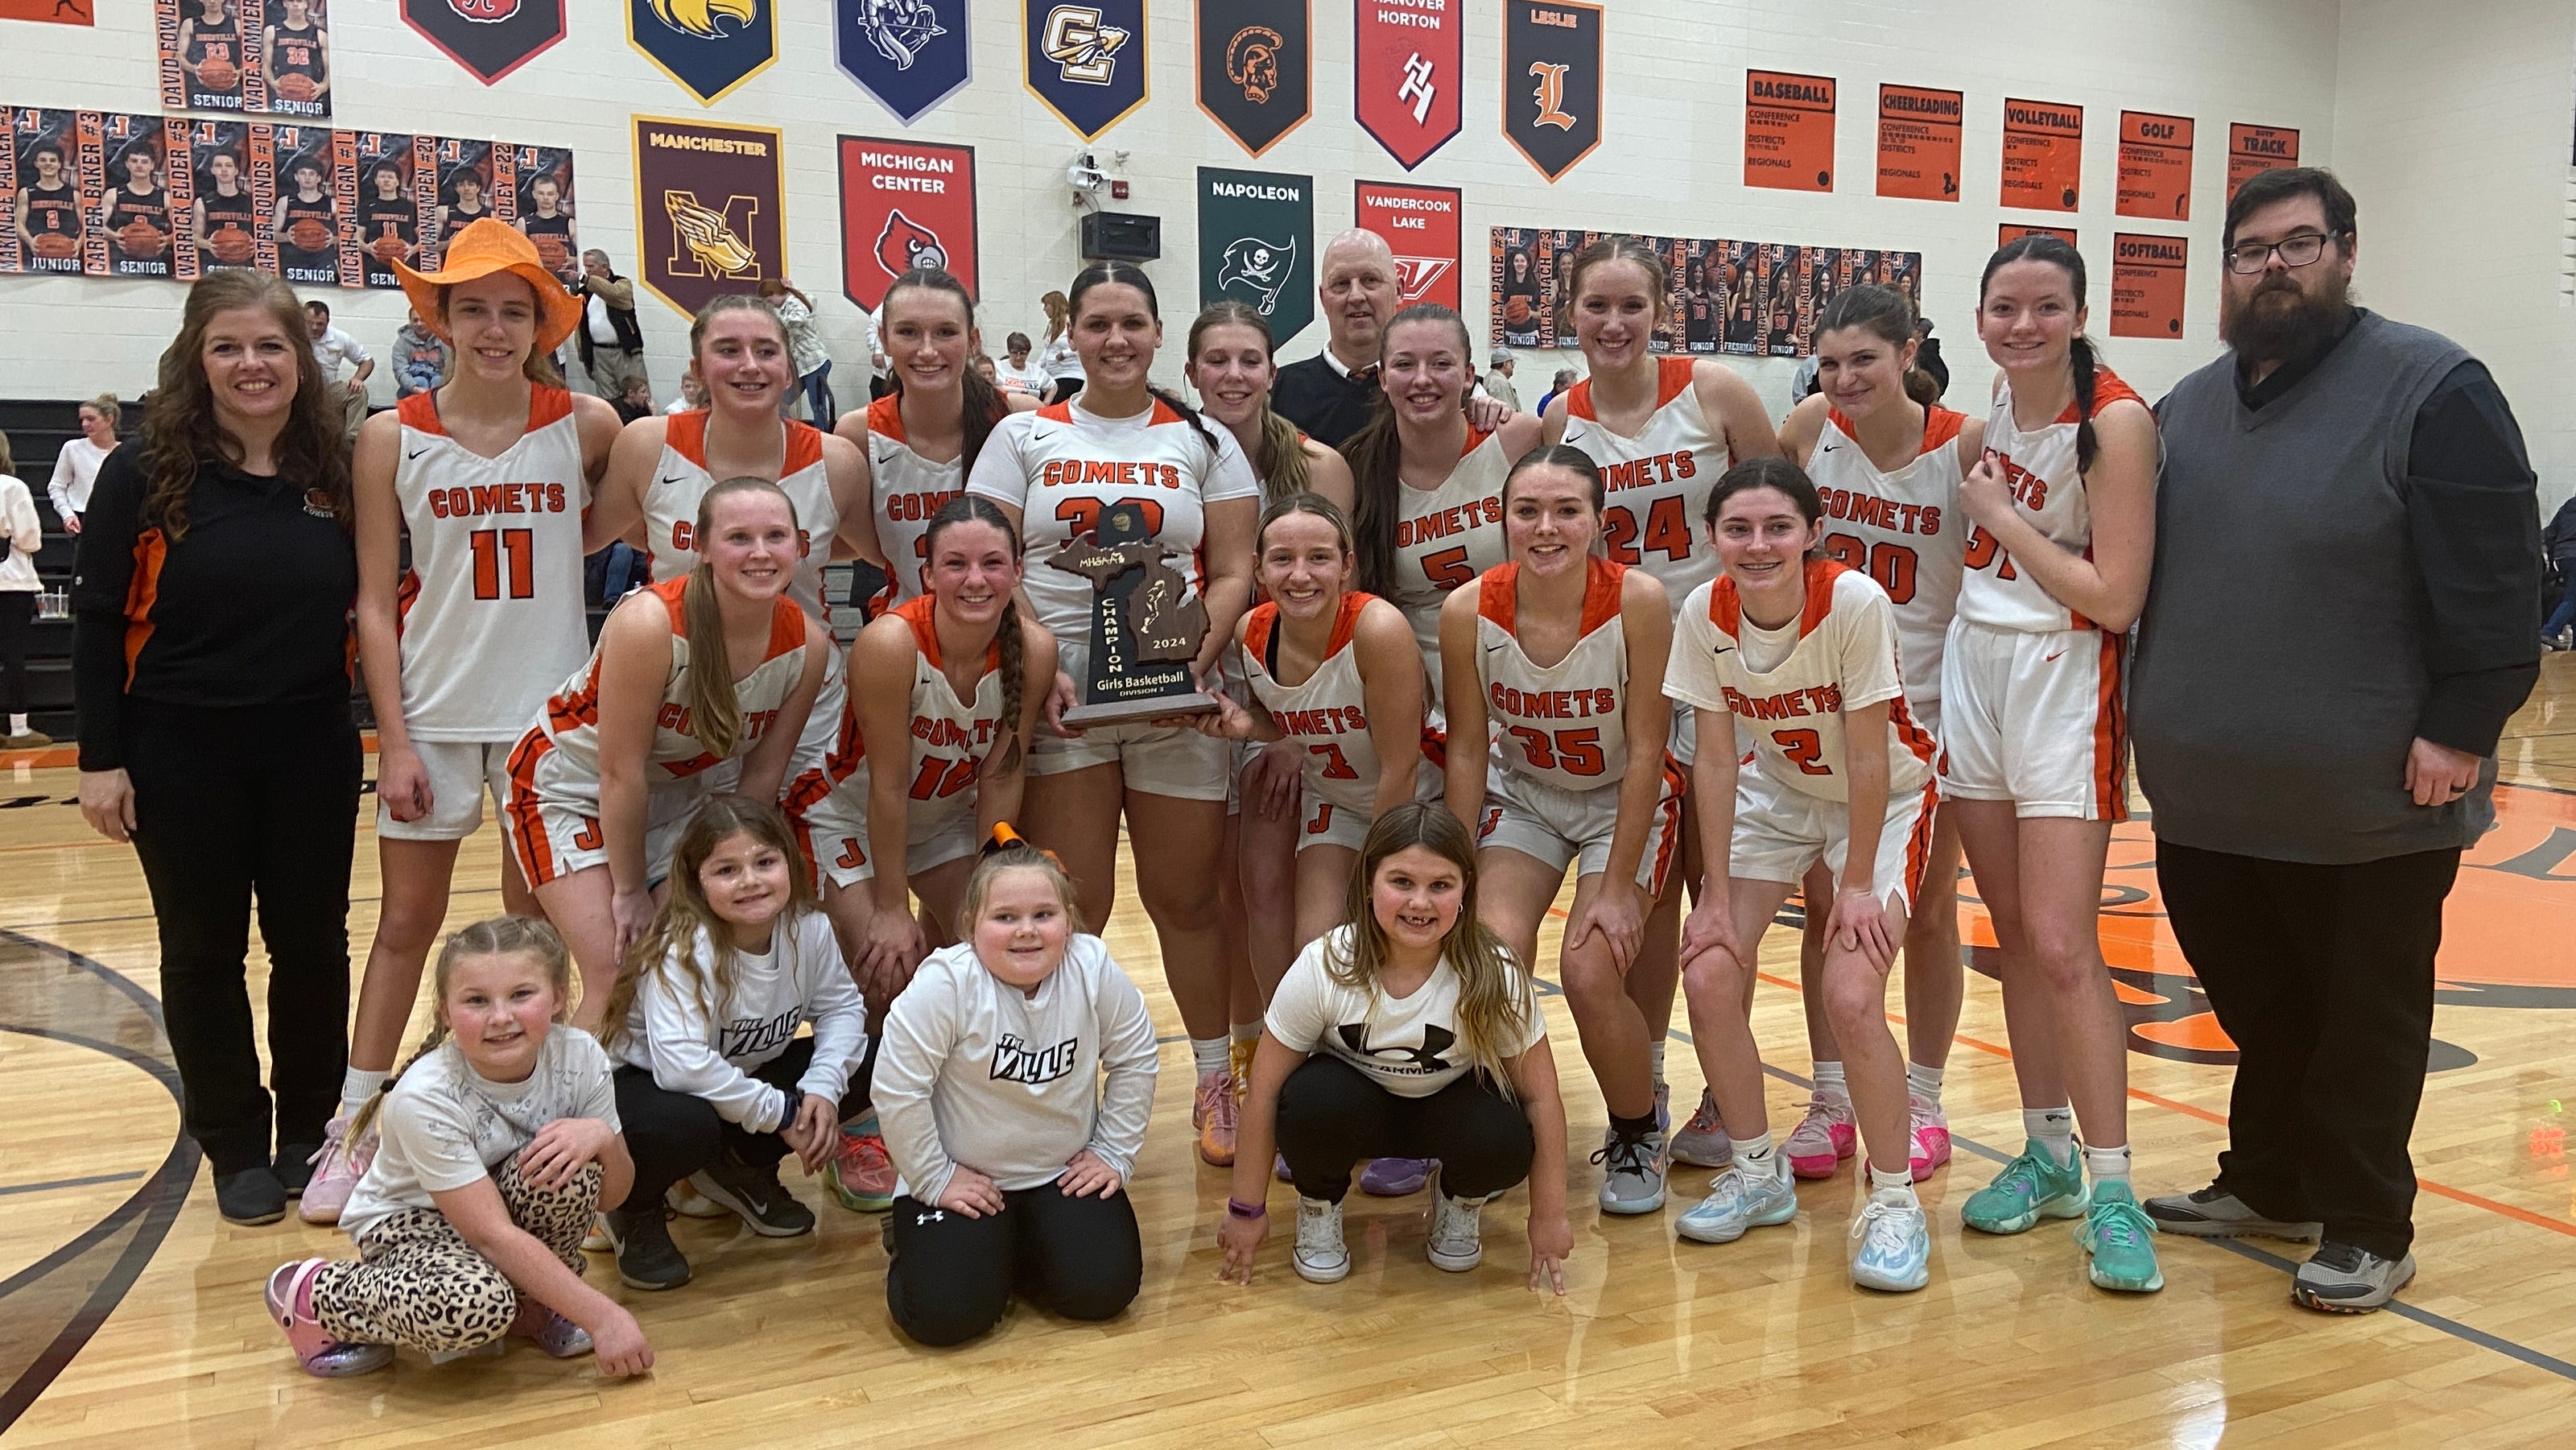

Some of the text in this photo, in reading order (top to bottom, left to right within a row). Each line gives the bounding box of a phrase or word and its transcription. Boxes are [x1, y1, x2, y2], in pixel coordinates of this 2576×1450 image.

[1373, 0, 1445, 11] OVER
[1377, 10, 1440, 30] HORTON
[1530, 9, 1578, 29] LESLIE
[162, 58, 183, 107] DAVID
[245, 68, 264, 110] WADE
[1753, 81, 1830, 104] BASEBALL
[194, 93, 243, 109] SENIOR
[275, 98, 324, 115] SENIOR
[1529, 61, 1578, 132] L
[1883, 93, 1959, 117] CHEERLEADING
[1748, 109, 1801, 122] CONFERENCE
[2007, 108, 2079, 130] VOLLEYBALL
[1748, 134, 1785, 146] DISTRICTS
[1880, 122, 1930, 134] CONFERENCE
[2140, 122, 2175, 139] GOLF
[649, 132, 767, 157] MANCHESTER
[1880, 143, 1916, 155] DISTRICTS
[2005, 135, 2051, 147] CONFERENCE
[2243, 136, 2287, 155] TRACK
[861, 151, 954, 174] MICHIGAN
[1748, 157, 1792, 168] REGIONALS
[1879, 167, 1921, 179] REGIONALS
[2004, 156, 2038, 167] DISTRICTS
[80, 112, 105, 272] CARTER BAKER #3
[494, 144, 515, 226] ADLEY #22
[871, 174, 945, 195] CENTER
[1212, 181, 1300, 203] NAPOLEON
[167, 119, 196, 277] WARRICK ELDER #5
[251, 125, 275, 270] ARTER ROUNDS #10
[336, 130, 361, 284] MICAH CALLIGAN #11
[415, 135, 439, 273] VIN VANKAMPEN #20
[1365, 195, 1452, 213] VANDERCOOK
[0, 196, 19, 271] MAKINLEE
[1391, 216, 1426, 230] LAKE
[1760, 244, 1769, 268] #20
[1881, 251, 1891, 275] #32
[2119, 242, 2182, 260] SOFTBALL
[32, 257, 80, 271] JUNIOR
[120, 260, 167, 275] SENIOR
[287, 267, 335, 282] SENIOR
[1492, 229, 1504, 347] KARLY PAGE #2
[1539, 231, 1554, 349] HALEY MACH #3
[1800, 273, 1810, 308] HAGER
[1841, 272, 1851, 292] ACH
[1674, 238, 1686, 353] REESE STANTON #10
[1693, 304, 1707, 320] 10
[1509, 335, 1537, 346] JUNIOR
[1558, 337, 1579, 346] JUNIO
[1648, 340, 1670, 349] ENIOR
[1757, 313, 1767, 354] KORRA
[1799, 312, 1809, 357] GRACEN
[1690, 341, 1715, 351] JUNIOR
[1724, 341, 1757, 352] FRESHMAN
[1770, 345, 1795, 354] JUNIOR
[1042, 459, 1180, 490] COMETS
[1597, 449, 1697, 494] OMETS
[1981, 446, 2049, 512] ETS
[427, 482, 566, 519] COMETS
[1817, 485, 1942, 535] COMETS
[1397, 495, 1503, 548] OMETS
[1601, 493, 1693, 566] 24
[469, 527, 535, 601] 11
[1419, 544, 1477, 591] 5
[1824, 531, 1919, 605] 30
[1100, 597, 1123, 674] CHAMPION
[1152, 637, 1187, 650] 2024
[1096, 671, 1184, 692] Girls Basketball
[1119, 687, 1157, 697] DIVISION
[1490, 681, 1616, 721] COMETS
[1720, 682, 1843, 721] COMETS
[1272, 704, 1367, 737] OMETS
[1508, 725, 1607, 777] 35
[1770, 728, 1833, 776] 2
[1307, 803, 1335, 835] J
[1480, 808, 1504, 837] J
[574, 815, 605, 851] J
[835, 837, 867, 870] J
[719, 1003, 803, 1060] VILLE
[989, 1036, 1078, 1085] VILLE
[1379, 1064, 1439, 1076] ARMO
